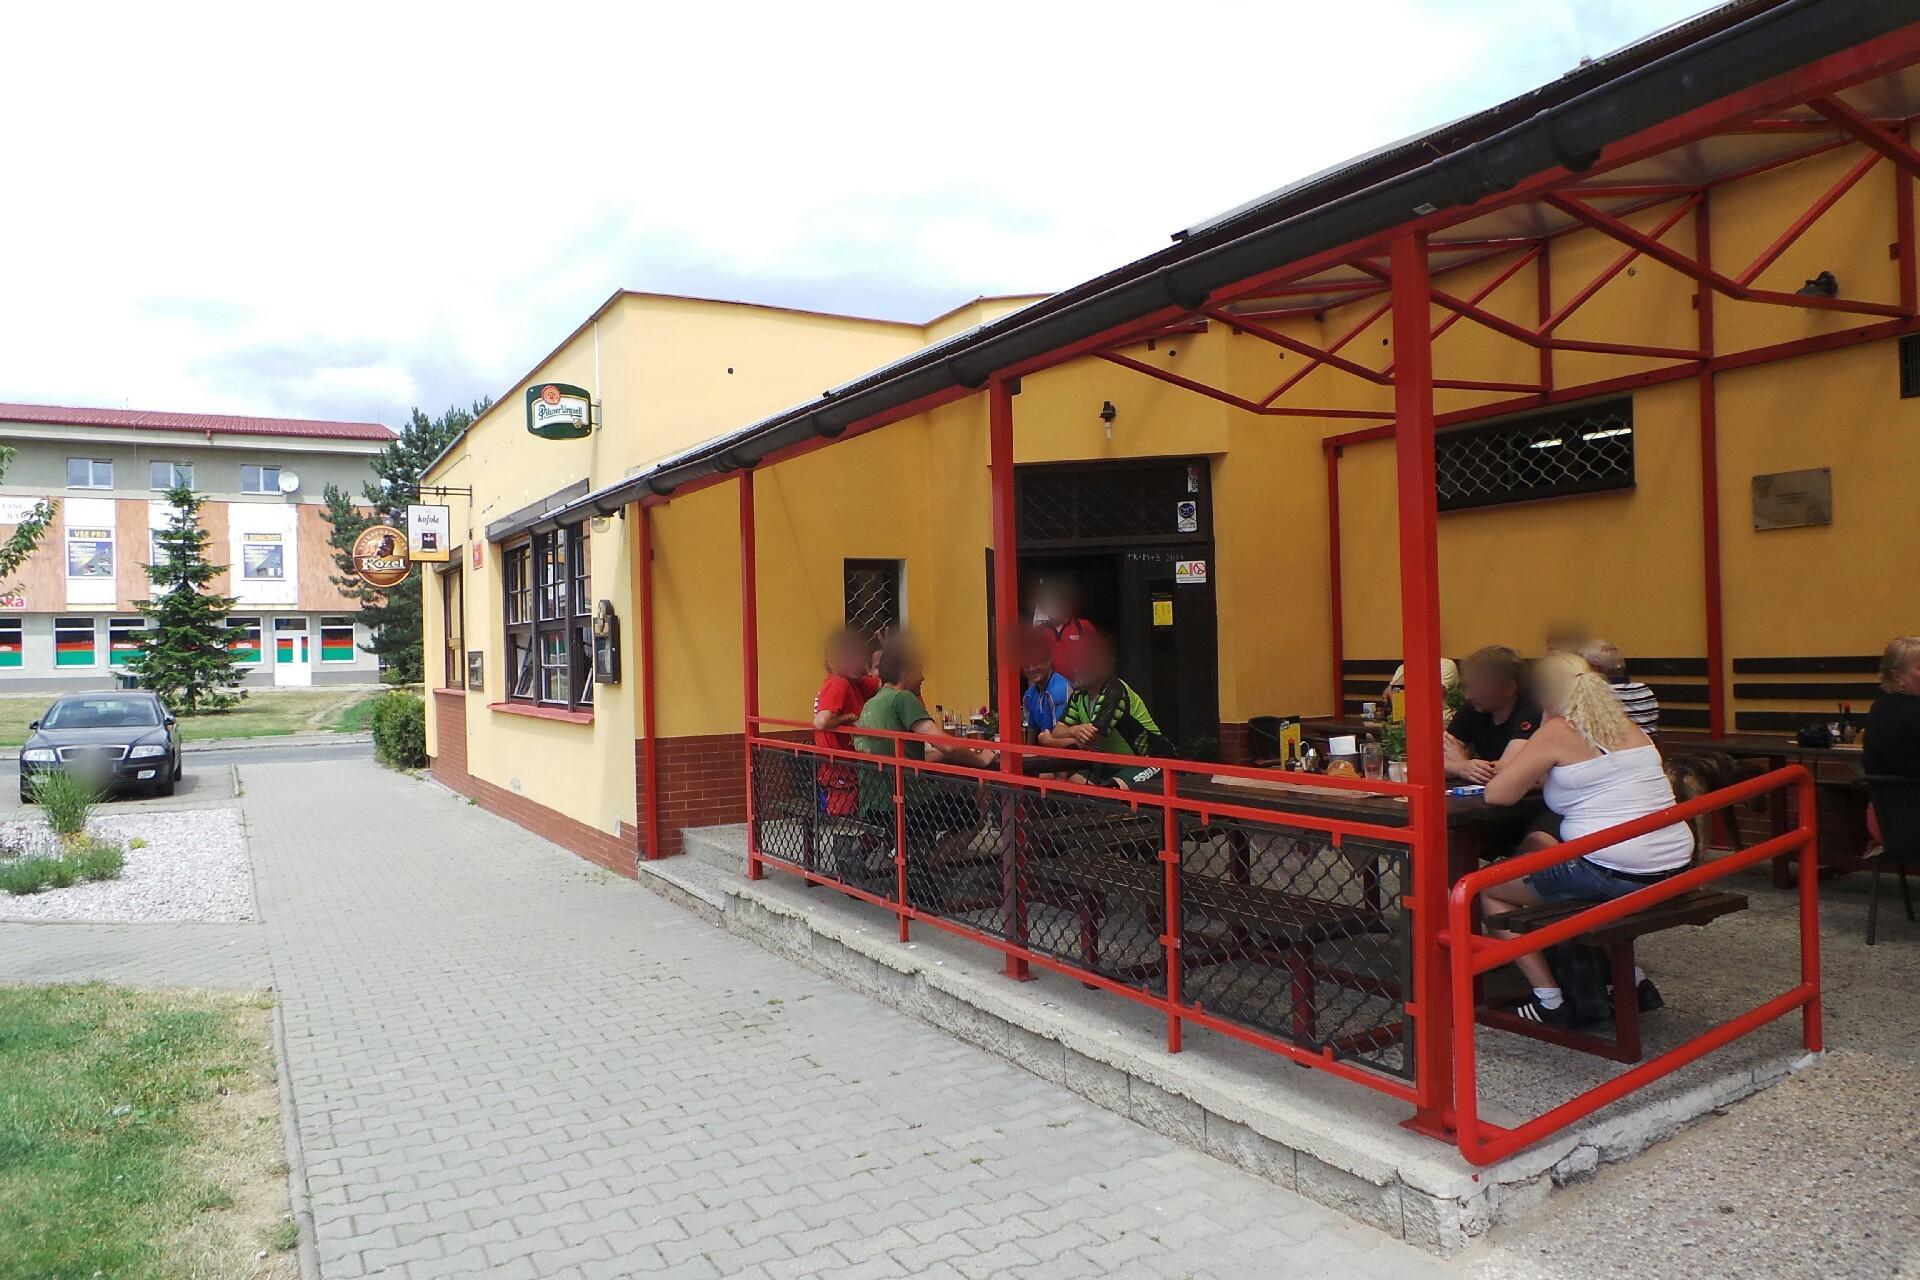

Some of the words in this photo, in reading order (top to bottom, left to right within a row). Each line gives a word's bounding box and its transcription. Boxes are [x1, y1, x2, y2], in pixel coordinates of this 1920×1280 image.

[538, 403, 561, 421] Pilsner
[561, 404, 583, 418] Urquell
[417, 514, 440, 525] kofola
[361, 557, 407, 571] Kozel
